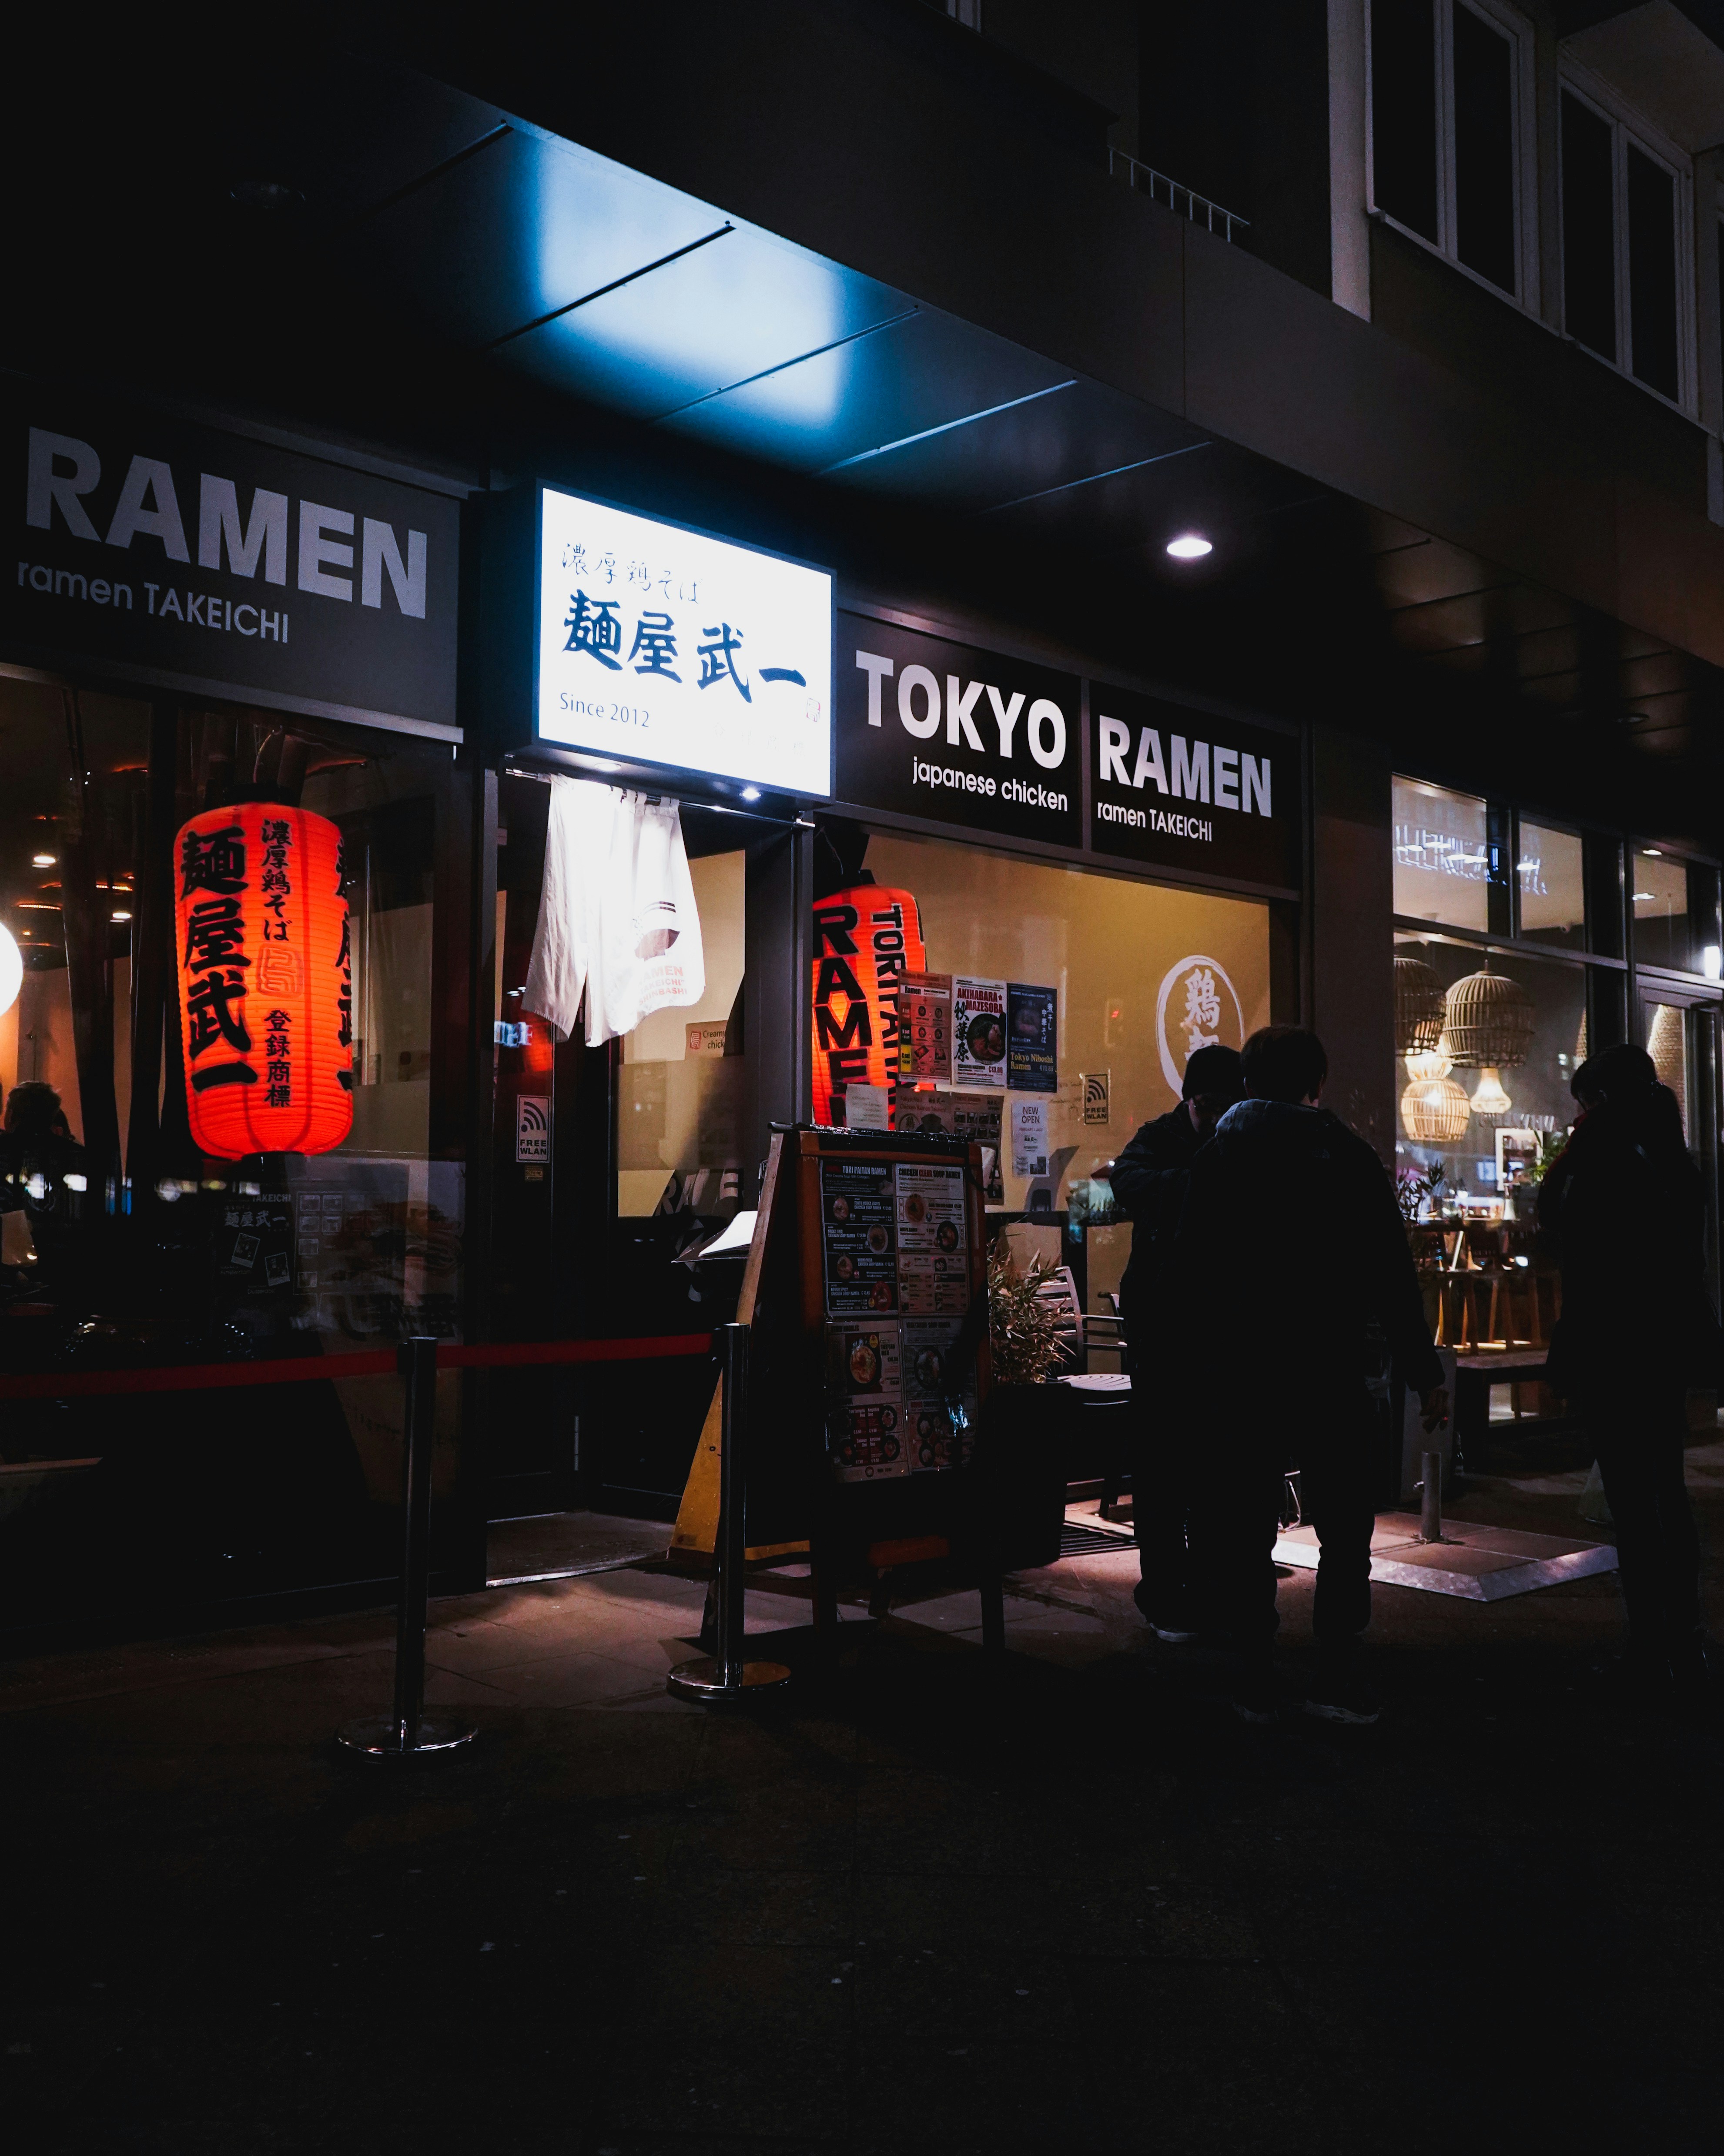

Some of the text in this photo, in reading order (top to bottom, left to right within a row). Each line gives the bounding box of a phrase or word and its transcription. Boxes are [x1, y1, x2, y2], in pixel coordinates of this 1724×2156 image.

[26, 426, 427, 619] RAMEN
[562, 543, 703, 604] 濃厚鶏そば
[18, 561, 288, 643] ramen TAKEICHI
[562, 589, 806, 703] 麺屋武一
[559, 692, 649, 728] Since 2012
[856, 650, 1272, 818] TOKYO RAMEN
[913, 756, 1068, 812] japanese chicken
[1097, 801, 1212, 842] ramen TAKEICHI
[261, 819, 292, 942] 濃厚鶏そば
[181, 826, 258, 1093] 麺屋武一
[639, 965, 683, 984] AMEN
[639, 987, 687, 1005] SHINBASHI
[905, 986, 921, 995] Ramen
[957, 988, 998, 1002] AKIHABARA
[965, 1000, 1003, 1013] MAZESOBA
[264, 1009, 292, 1108] 登録商標
[1011, 1052, 1029, 1062] Tokyo
[1011, 1061, 1031, 1070] Ramen
[843, 1166, 854, 1174] TORI
[854, 1167, 870, 1175] PAITAN
[899, 1168, 918, 1177] CHICKEN
[933, 1170, 945, 1178] SOUP
